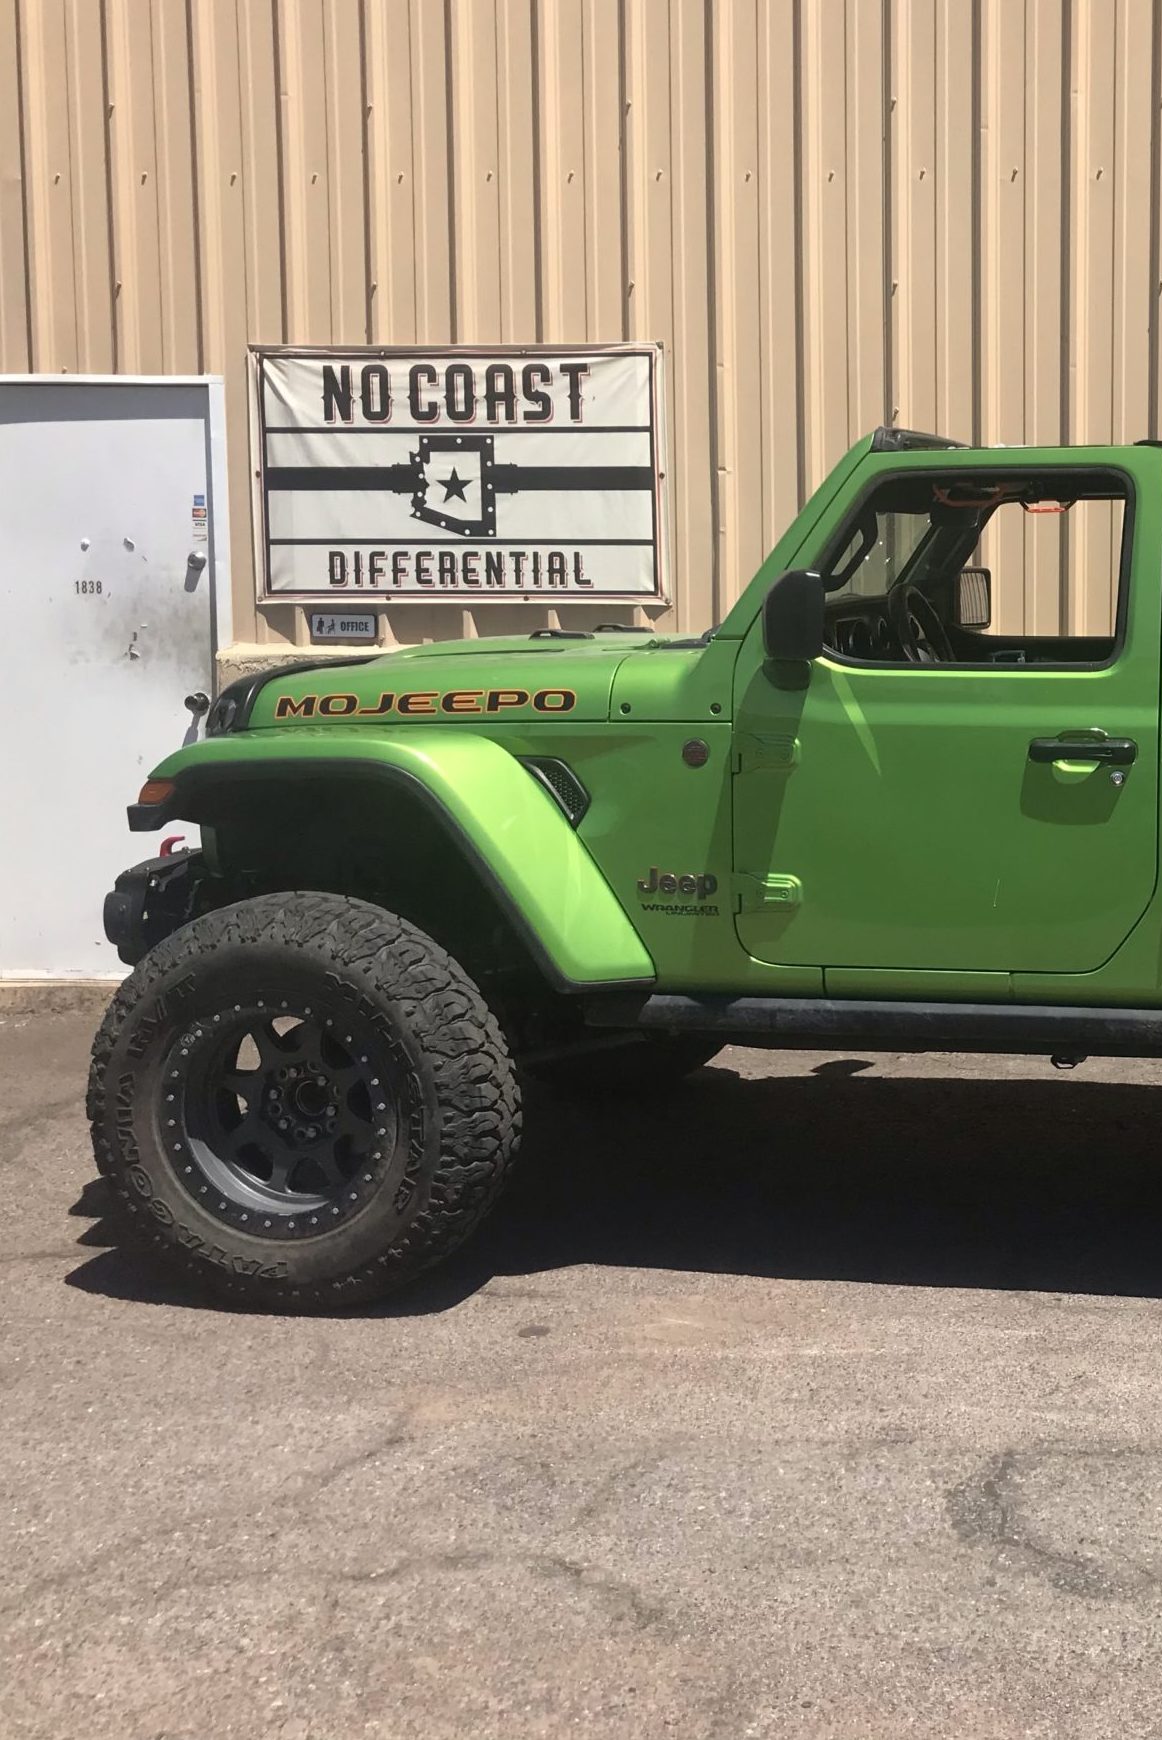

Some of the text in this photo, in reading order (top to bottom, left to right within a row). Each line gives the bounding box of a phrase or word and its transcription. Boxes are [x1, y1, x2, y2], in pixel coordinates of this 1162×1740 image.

[321, 363, 590, 423] NO COAST
[328, 550, 594, 588] DIFFERENTIAL
[75, 580, 102, 595] 1838
[340, 621, 369, 632] OFFICE
[274, 689, 577, 719] MOJEEPO
[637, 866, 719, 900] Jeep
[641, 903, 719, 913] WRANGLER
[116, 1073, 289, 1280] PATAGONIA
